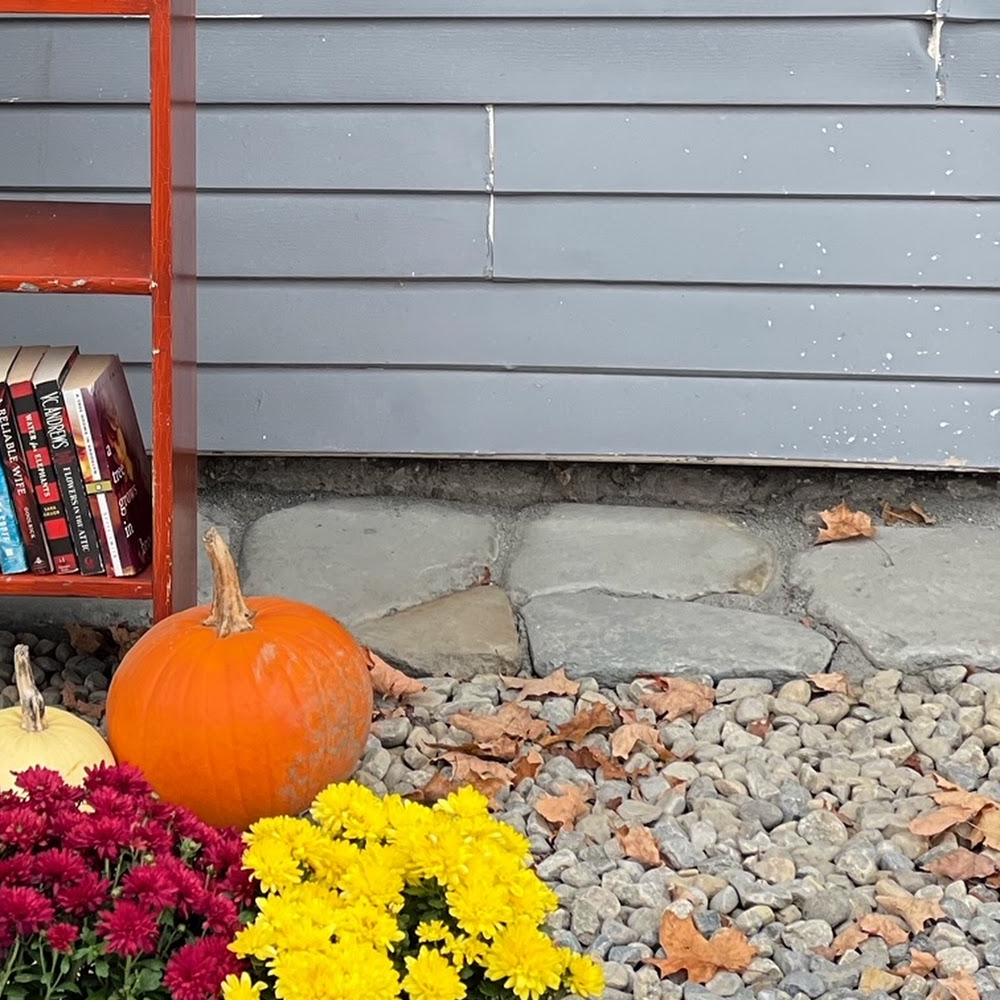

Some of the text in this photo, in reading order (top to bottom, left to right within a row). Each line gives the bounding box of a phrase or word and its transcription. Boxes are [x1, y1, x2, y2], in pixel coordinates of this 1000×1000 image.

[42, 405, 69, 450] ANDREWS
[24, 413, 37, 440] WATER
[33, 453, 50, 497] ELEPHANTS
[11, 465, 26, 495] WIFE
[62, 466, 78, 506] FLOWERS
[74, 515, 83, 527] THE
[77, 529, 91, 553] ATTIC
